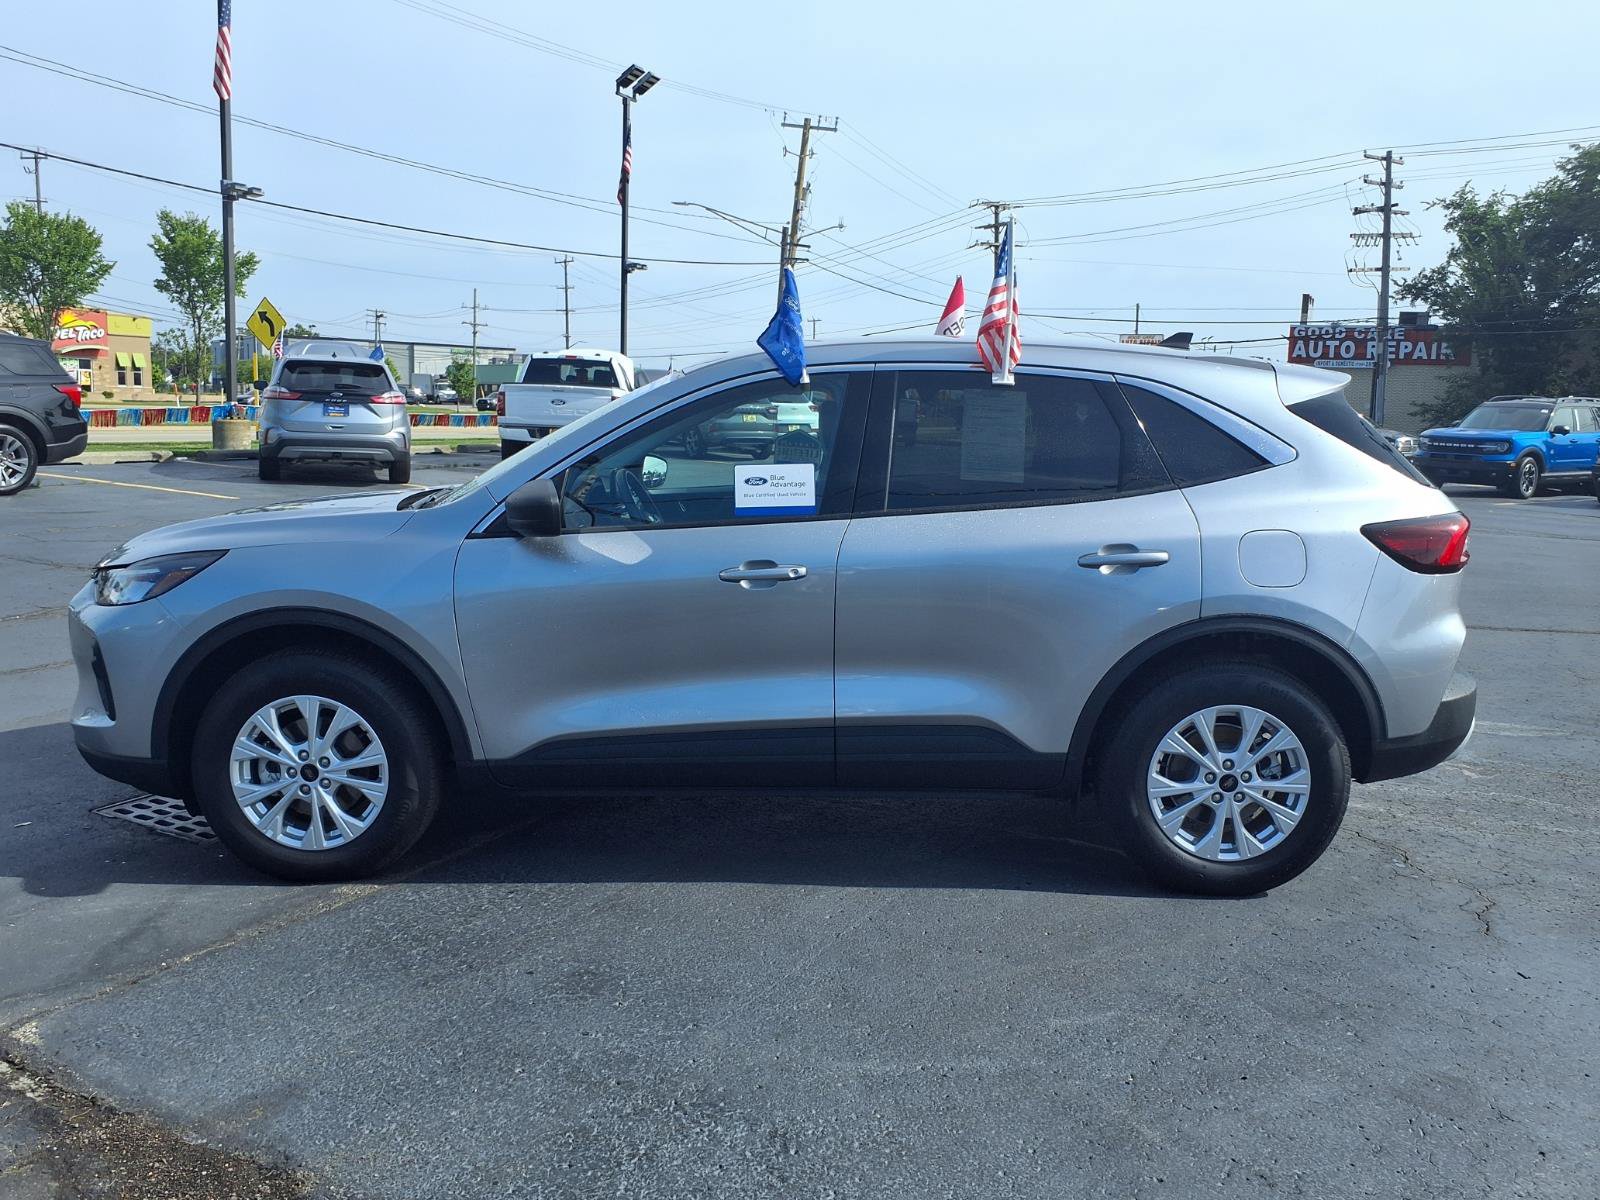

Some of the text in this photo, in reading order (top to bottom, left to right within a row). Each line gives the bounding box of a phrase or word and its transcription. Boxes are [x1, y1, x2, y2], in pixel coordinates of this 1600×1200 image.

[76, 327, 105, 341] TACO
[1294, 327, 1346, 339] GOOD
[1292, 340, 1355, 358] AUTO
